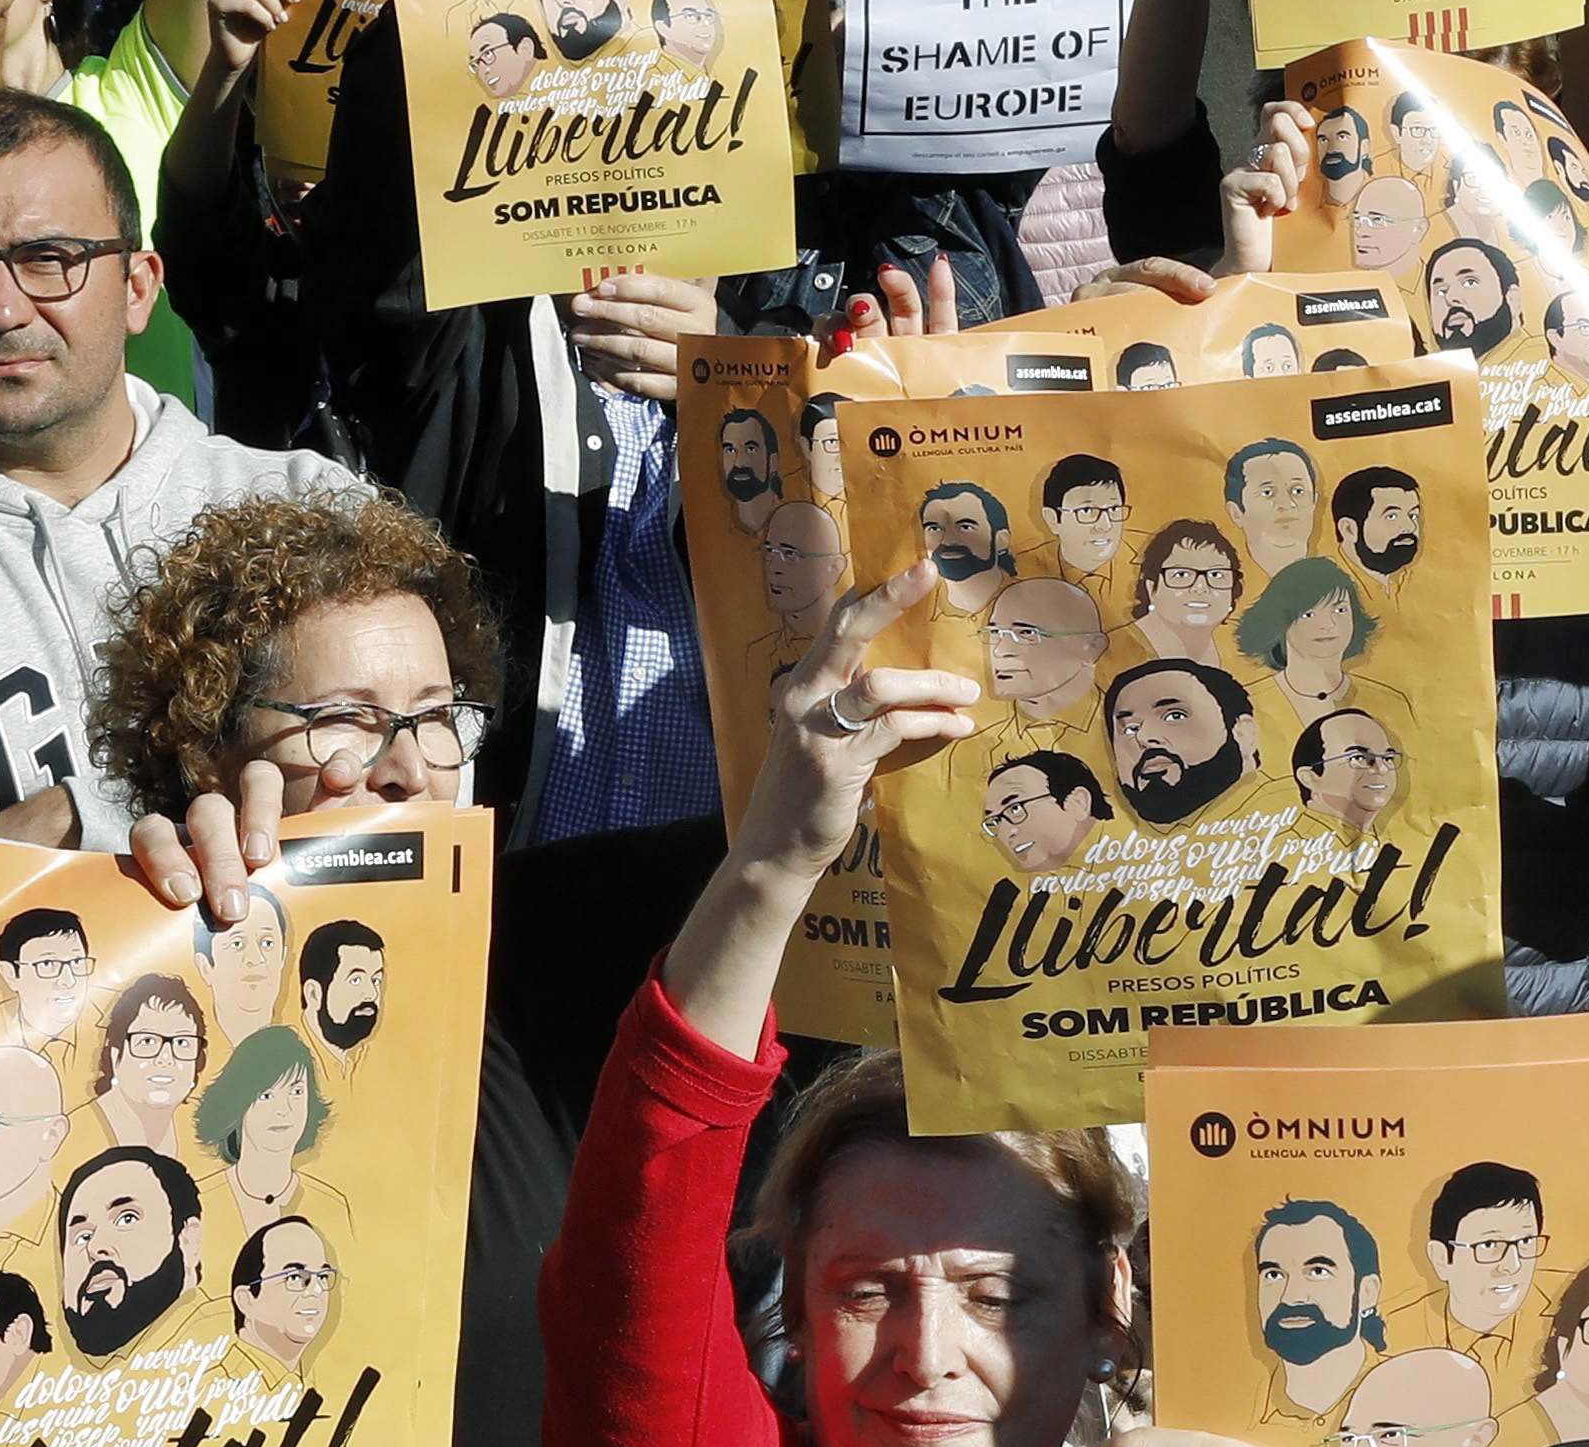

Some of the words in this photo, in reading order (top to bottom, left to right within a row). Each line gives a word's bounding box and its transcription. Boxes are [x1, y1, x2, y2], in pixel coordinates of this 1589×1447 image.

[881, 34, 1036, 73] SHAME
[1052, 26, 1111, 60] OF
[905, 84, 1082, 121] EUROPE
[444, 70, 758, 202] Llibertat!
[494, 198, 560, 225] SOM
[567, 185, 721, 217] REPÚBLICA
[1324, 395, 1442, 429] assemblea.cat
[910, 422, 1024, 445] ÒMNIUM
[912, 448, 955, 458] LLENGUA
[958, 445, 1001, 455] CULTURA
[1004, 443, 1024, 452] PAÍS
[938, 822, 1460, 1005] Llibertat!
[1108, 971, 1194, 995] PRESOS
[1201, 962, 1301, 988] POLÍTICS
[1021, 1007, 1128, 1040] SOM
[1142, 978, 1390, 1030] REPÚBLICA
[1247, 1112, 1406, 1139] ÒMNIUM
[1250, 1148, 1309, 1159] LLENGUA
[1314, 1147, 1374, 1158] CULTURA
[1380, 1145, 1406, 1157] PAÍS
